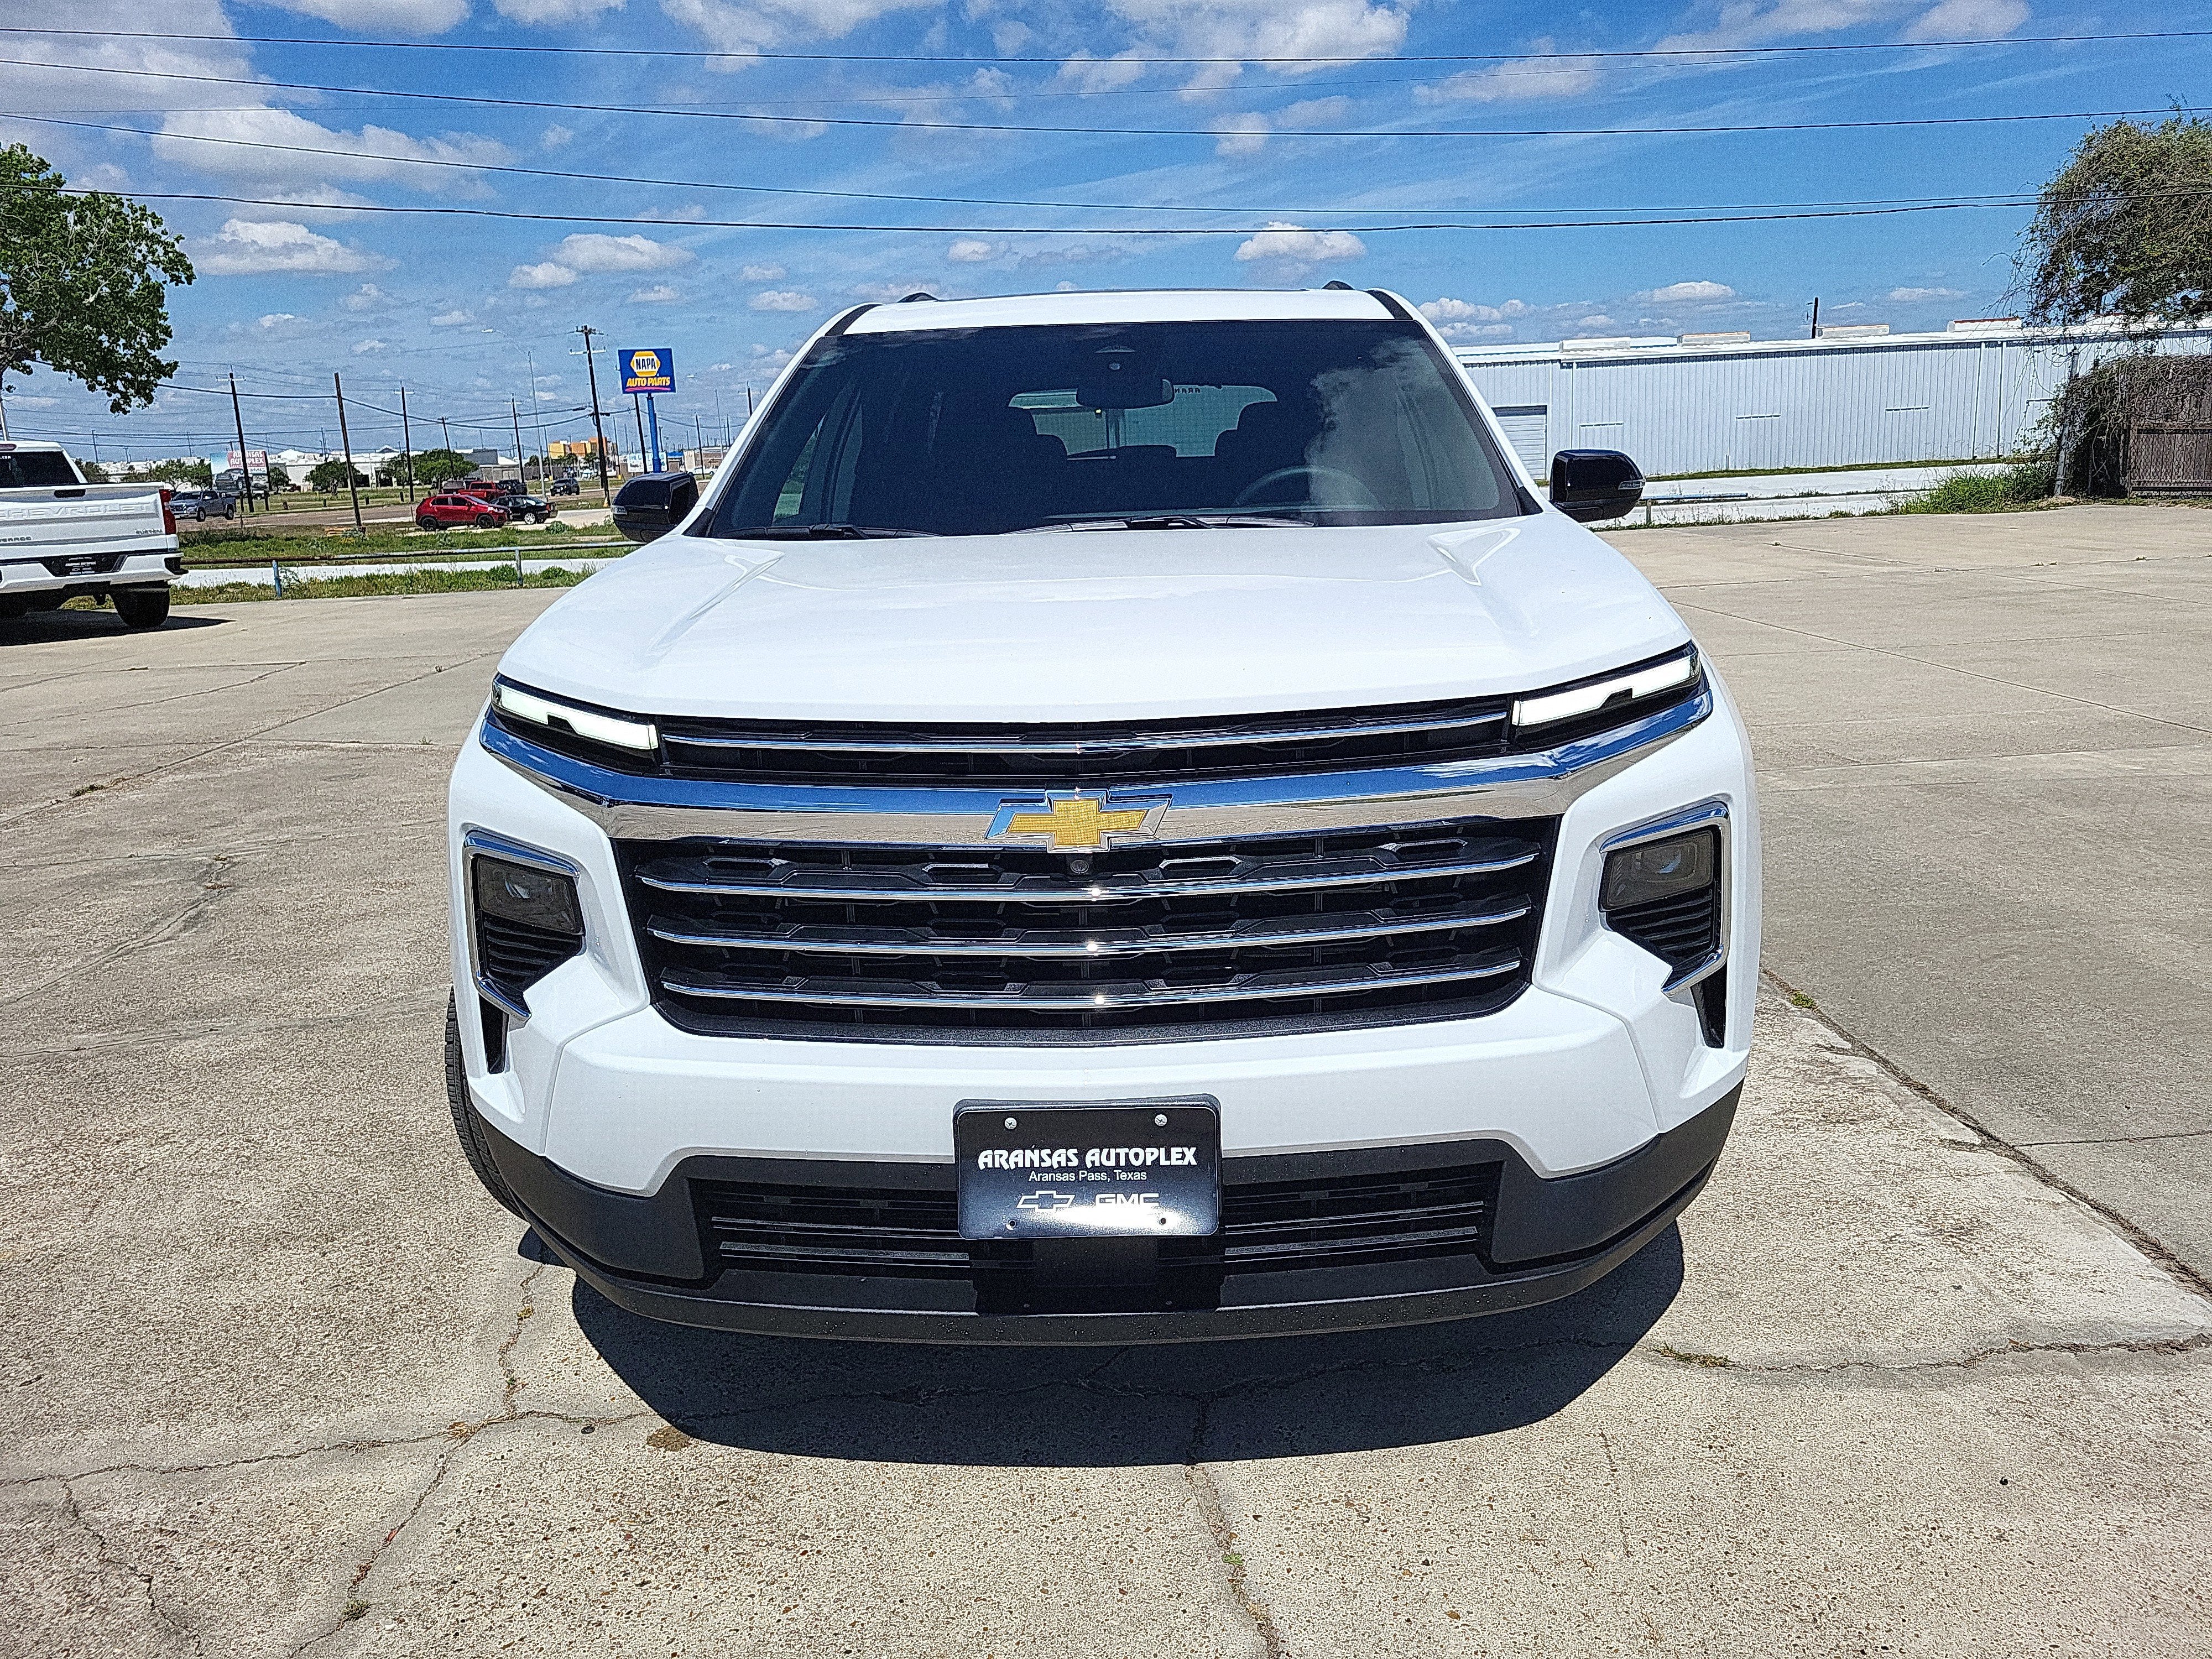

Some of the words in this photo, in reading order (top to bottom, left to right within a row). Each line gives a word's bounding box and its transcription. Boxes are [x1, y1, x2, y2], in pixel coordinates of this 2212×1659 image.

[635, 358, 656, 370] NAPA
[627, 378, 647, 387] AUTO
[647, 377, 671, 387] PARTS
[978, 1149, 1079, 1170] ARANSAS
[1085, 1147, 1198, 1168] AUTOPLEX
[1029, 1171, 1075, 1182] Aransas
[1079, 1170, 1110, 1182] Pass,
[1114, 1170, 1147, 1181] Texas
[1095, 1193, 1159, 1207] GMC
